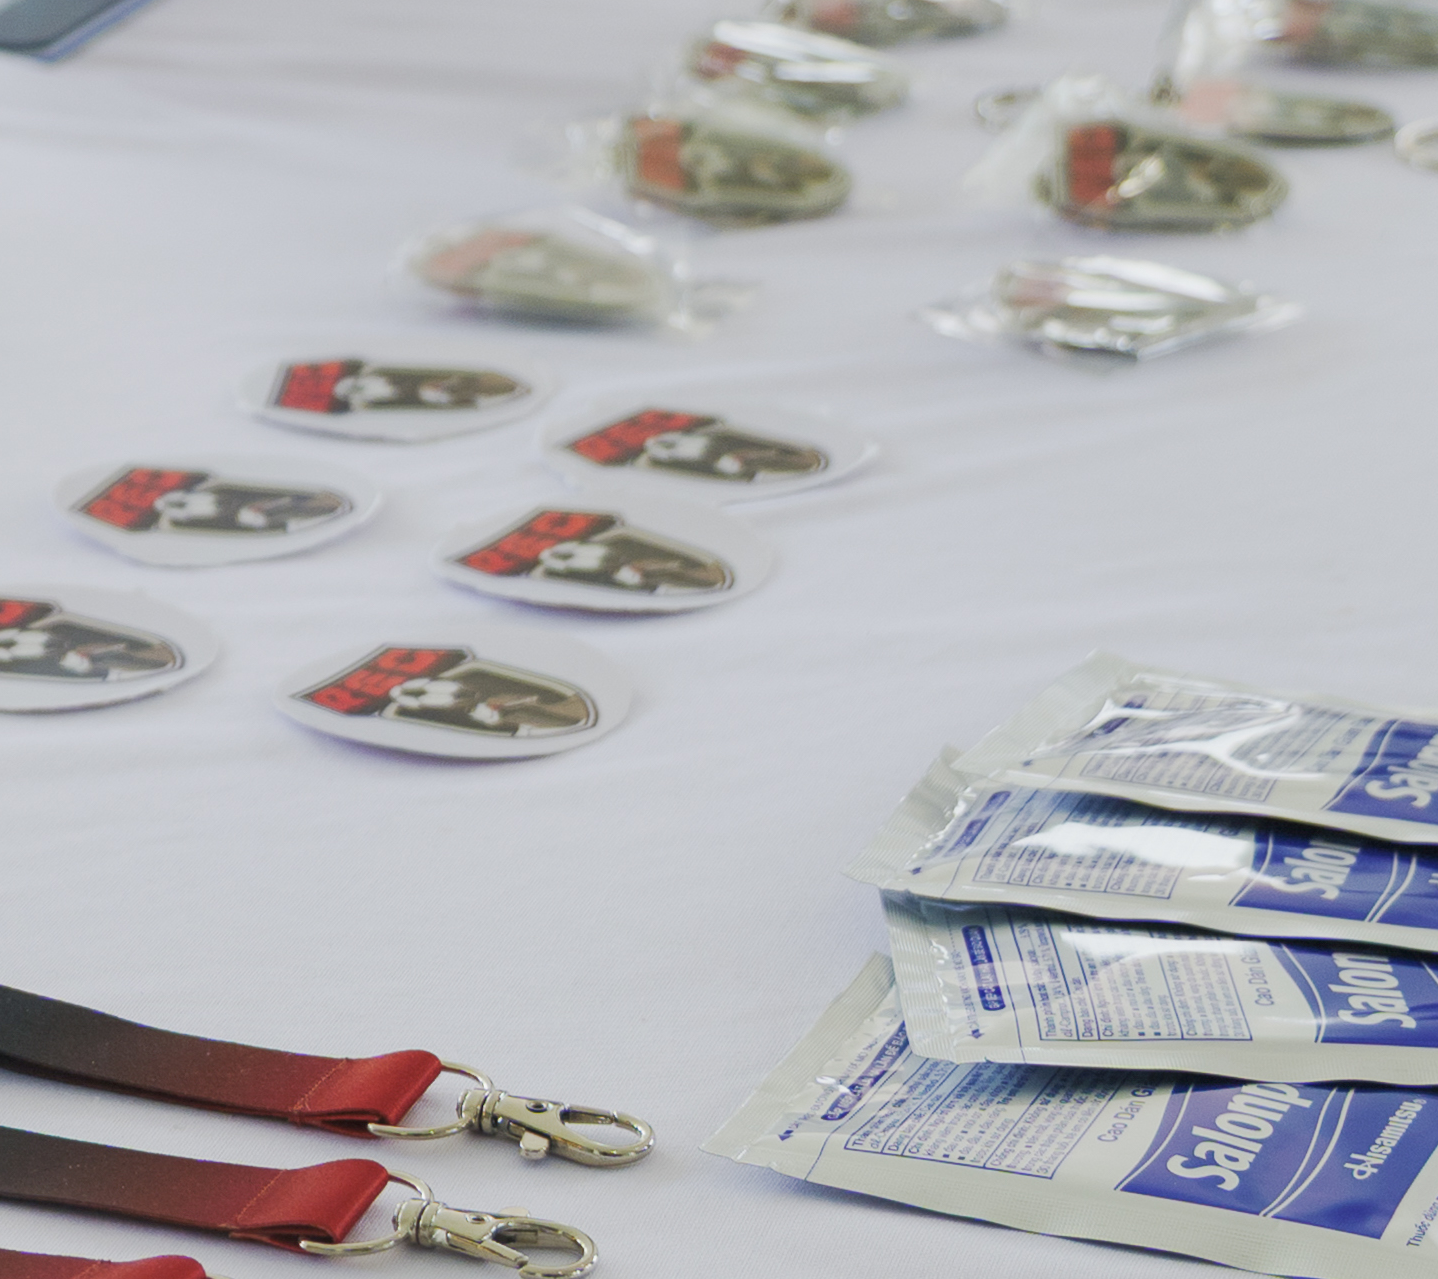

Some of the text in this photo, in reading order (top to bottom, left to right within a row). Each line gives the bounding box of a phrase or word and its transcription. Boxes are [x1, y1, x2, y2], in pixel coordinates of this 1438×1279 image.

[1327, 952, 1418, 1030] Salon
[1096, 1099, 1146, 1143] Cao Dán
[1166, 1082, 1315, 1191] Salonp
[1406, 1221, 1431, 1248] Thuốc
